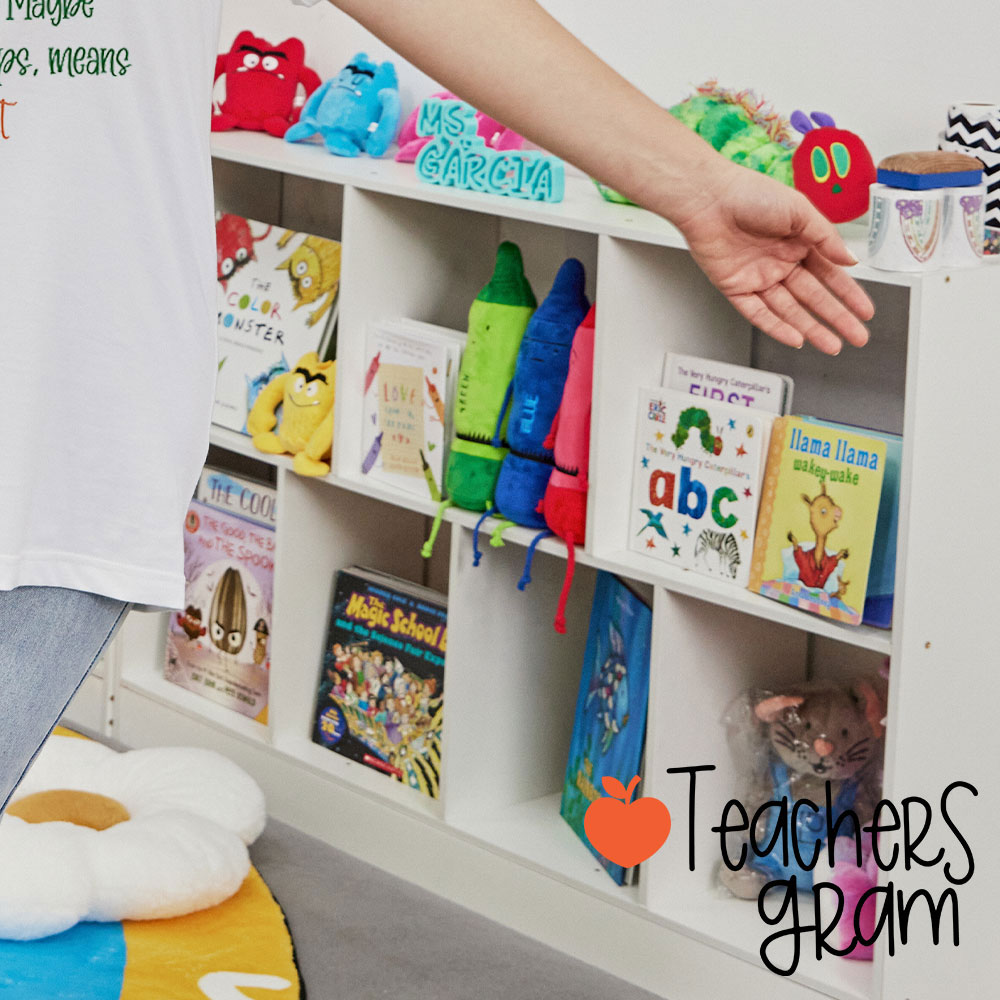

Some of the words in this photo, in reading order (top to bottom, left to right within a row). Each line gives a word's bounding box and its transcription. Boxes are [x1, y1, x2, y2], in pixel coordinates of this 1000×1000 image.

[47, 44, 132, 78] means
[418, 144, 553, 199] GARCIA
[251, 277, 272, 292] THE
[226, 291, 282, 320] COLOR
[790, 427, 831, 459] llama
[834, 438, 879, 470] llama
[211, 478, 233, 506] THE
[648, 466, 739, 529] abc
[345, 592, 391, 628] Magic
[389, 607, 442, 647] School
[368, 595, 385, 610] The
